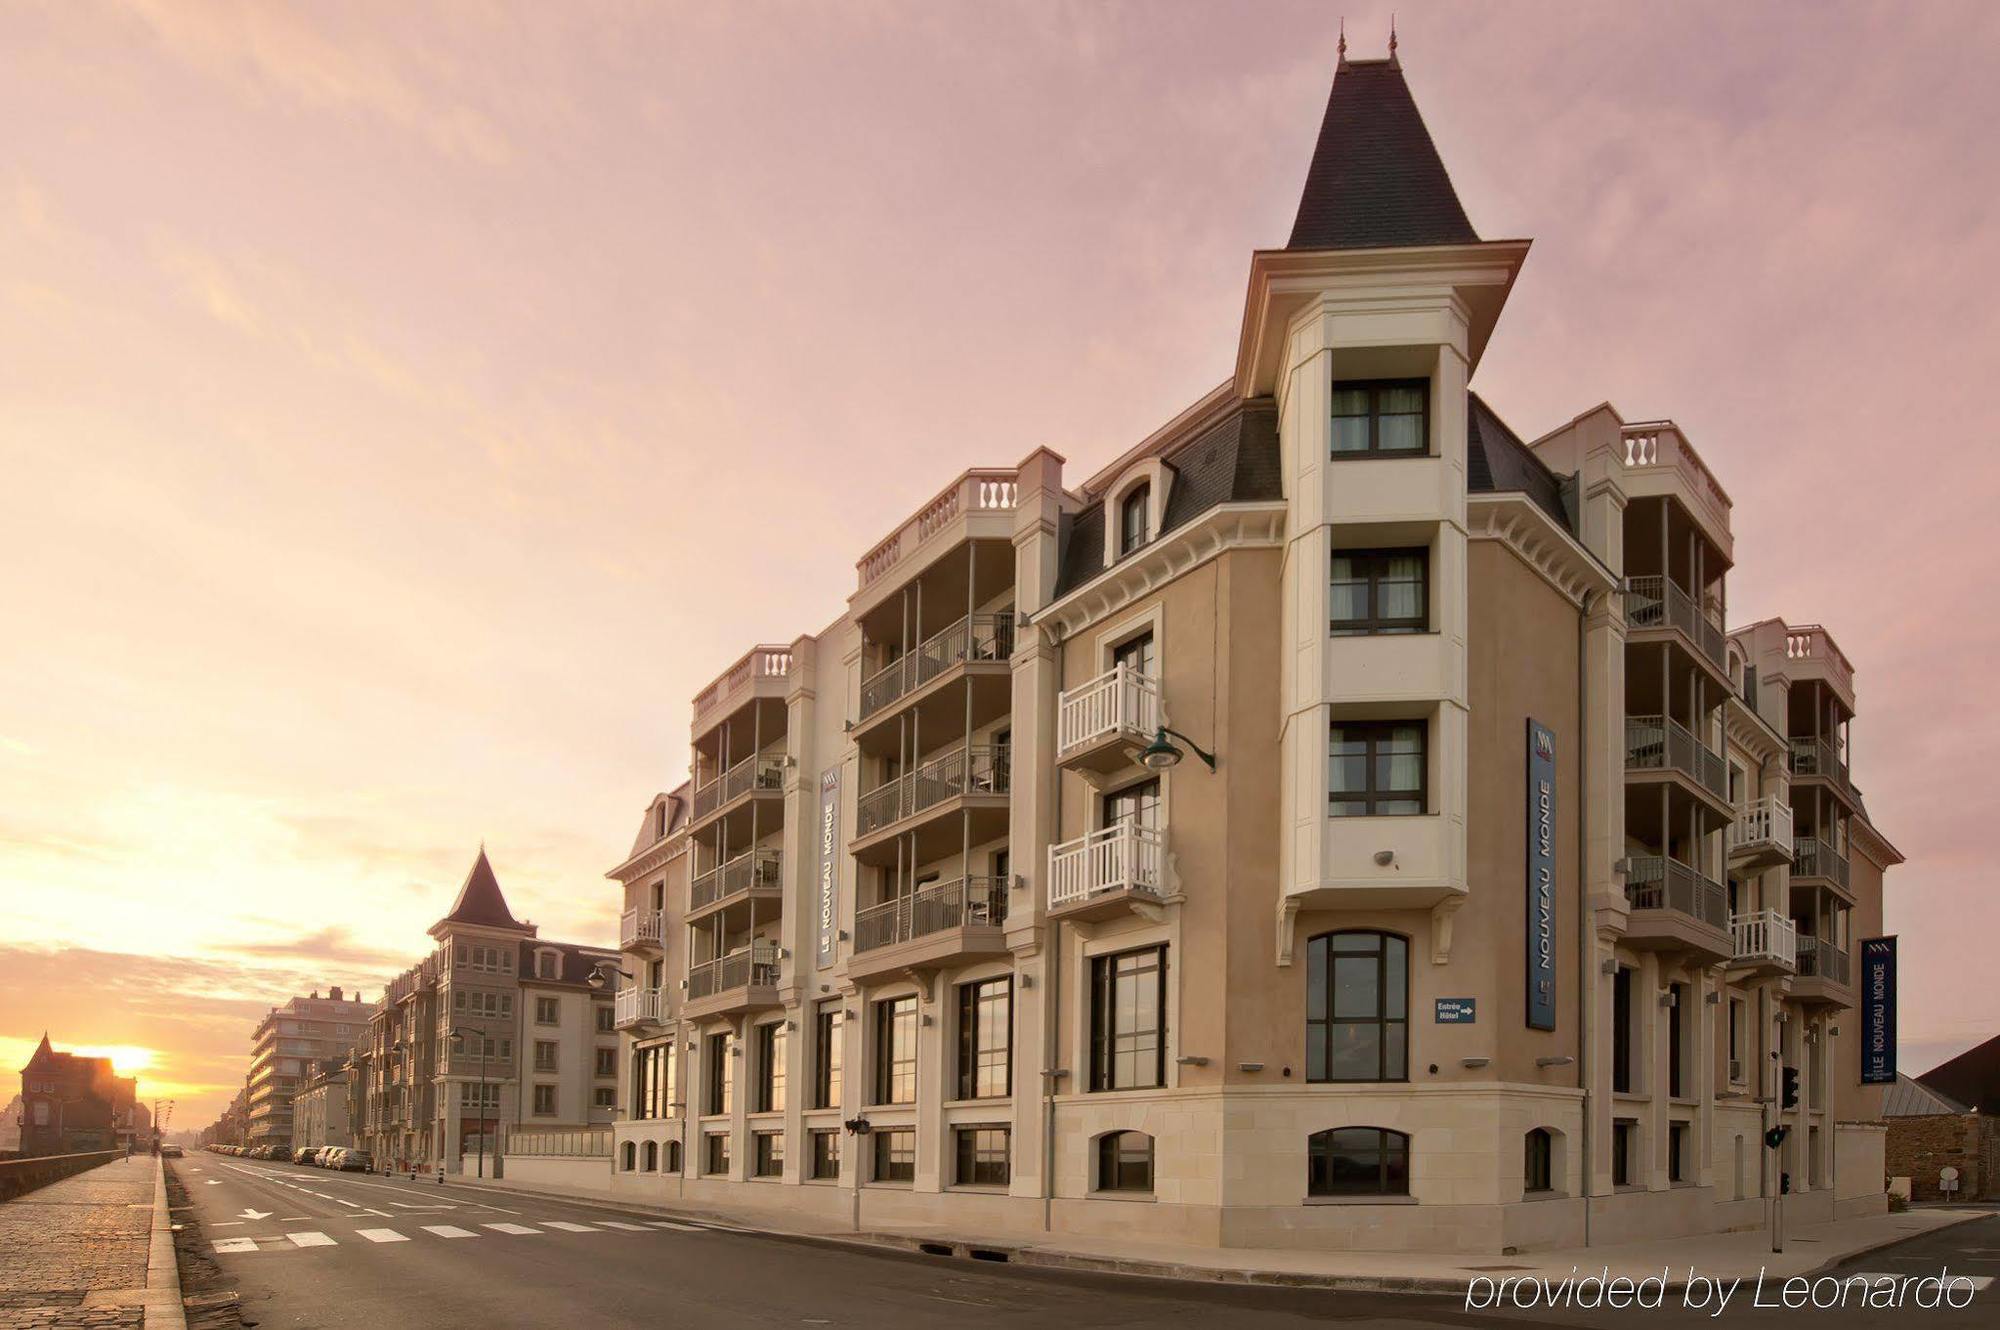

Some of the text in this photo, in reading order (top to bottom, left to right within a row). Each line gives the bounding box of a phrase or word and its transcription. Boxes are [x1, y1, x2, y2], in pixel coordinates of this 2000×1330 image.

[821, 802, 834, 954] LE NOUVEAU MONDE
[1538, 779, 1551, 1007] LE NOUVEAU MONDE
[1874, 963, 1884, 1068] LE NOUVEAU MONDE
